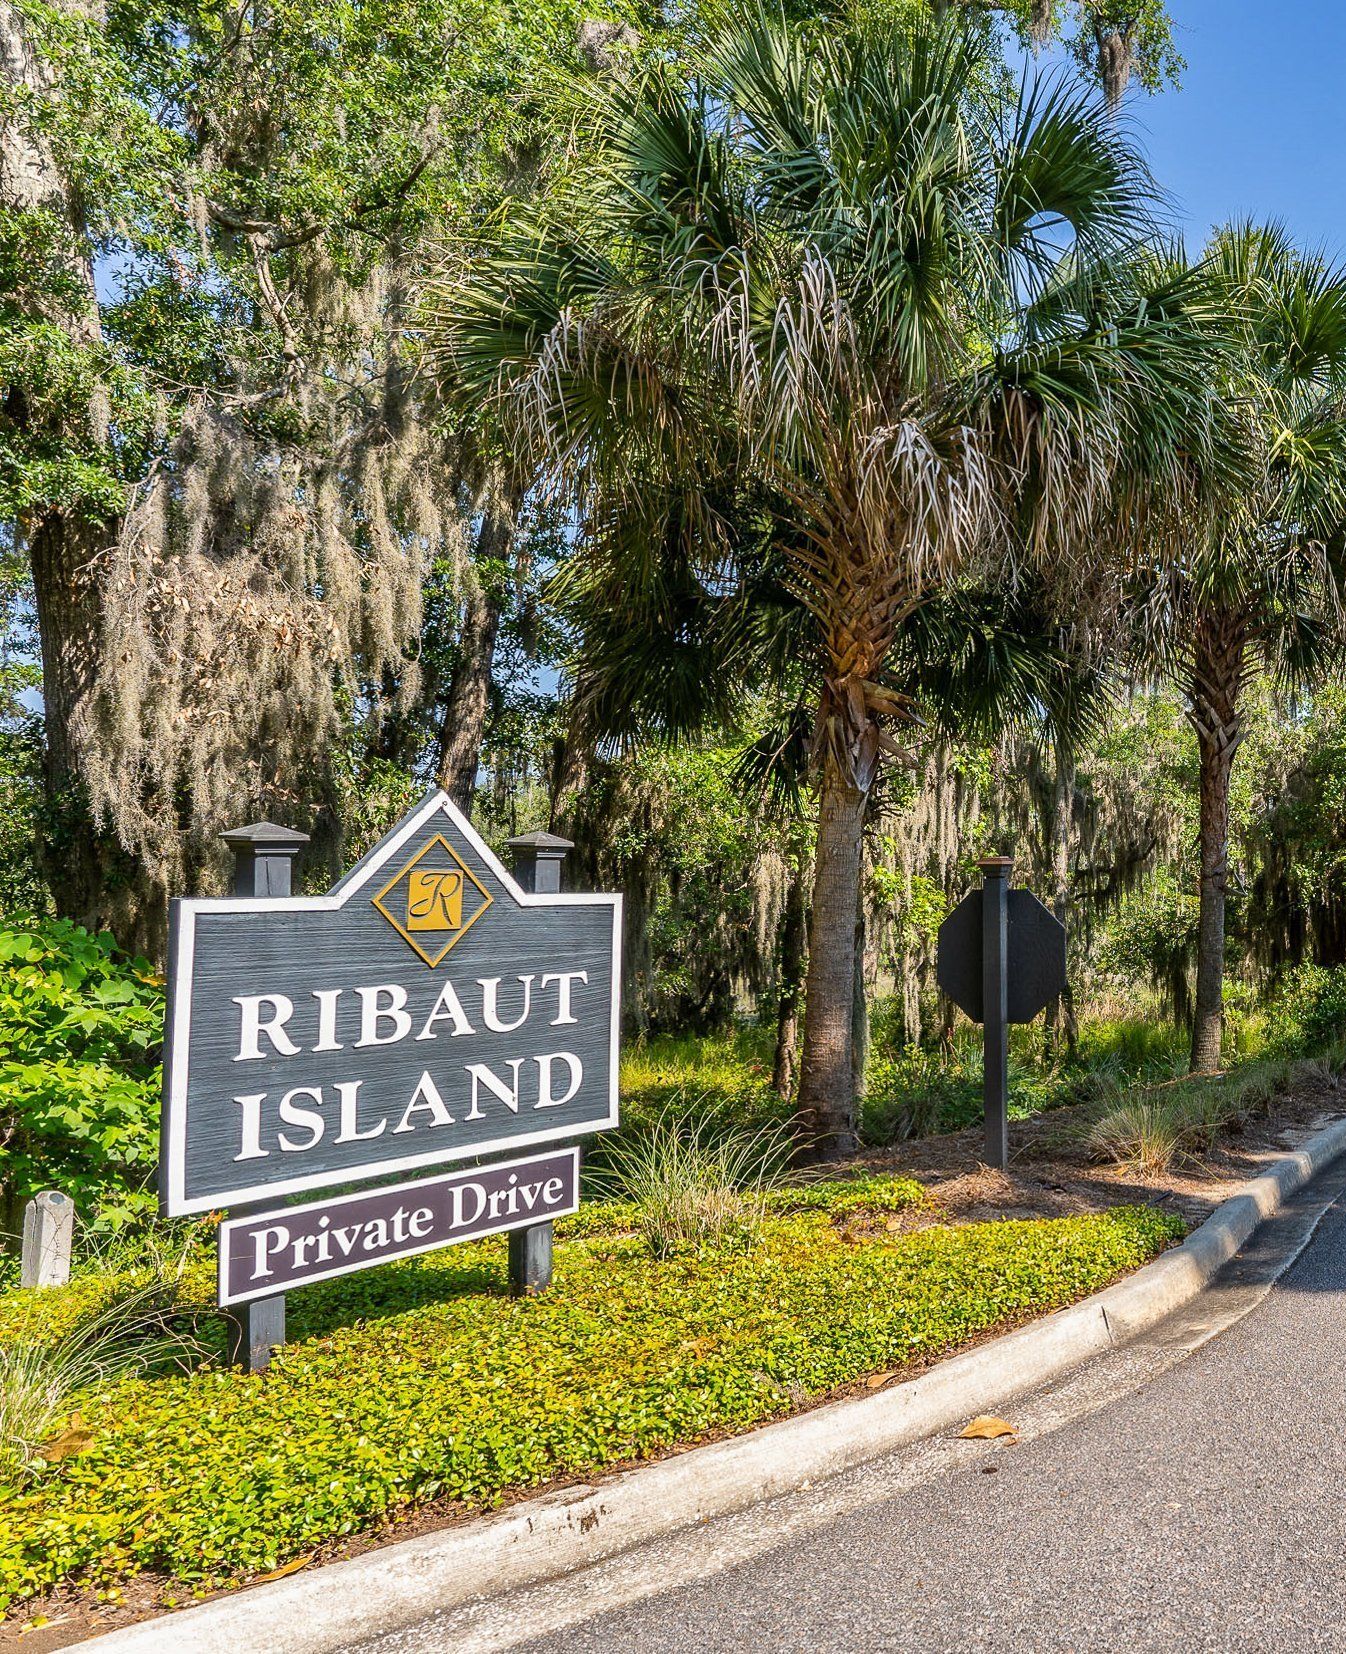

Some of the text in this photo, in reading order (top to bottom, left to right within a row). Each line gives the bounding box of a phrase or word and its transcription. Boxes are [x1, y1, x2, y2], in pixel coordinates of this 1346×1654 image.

[409, 872, 461, 926] R
[231, 970, 589, 1063] RIBAUT
[232, 1051, 584, 1162] ISLAND
[248, 1173, 565, 1282] Private Drive
